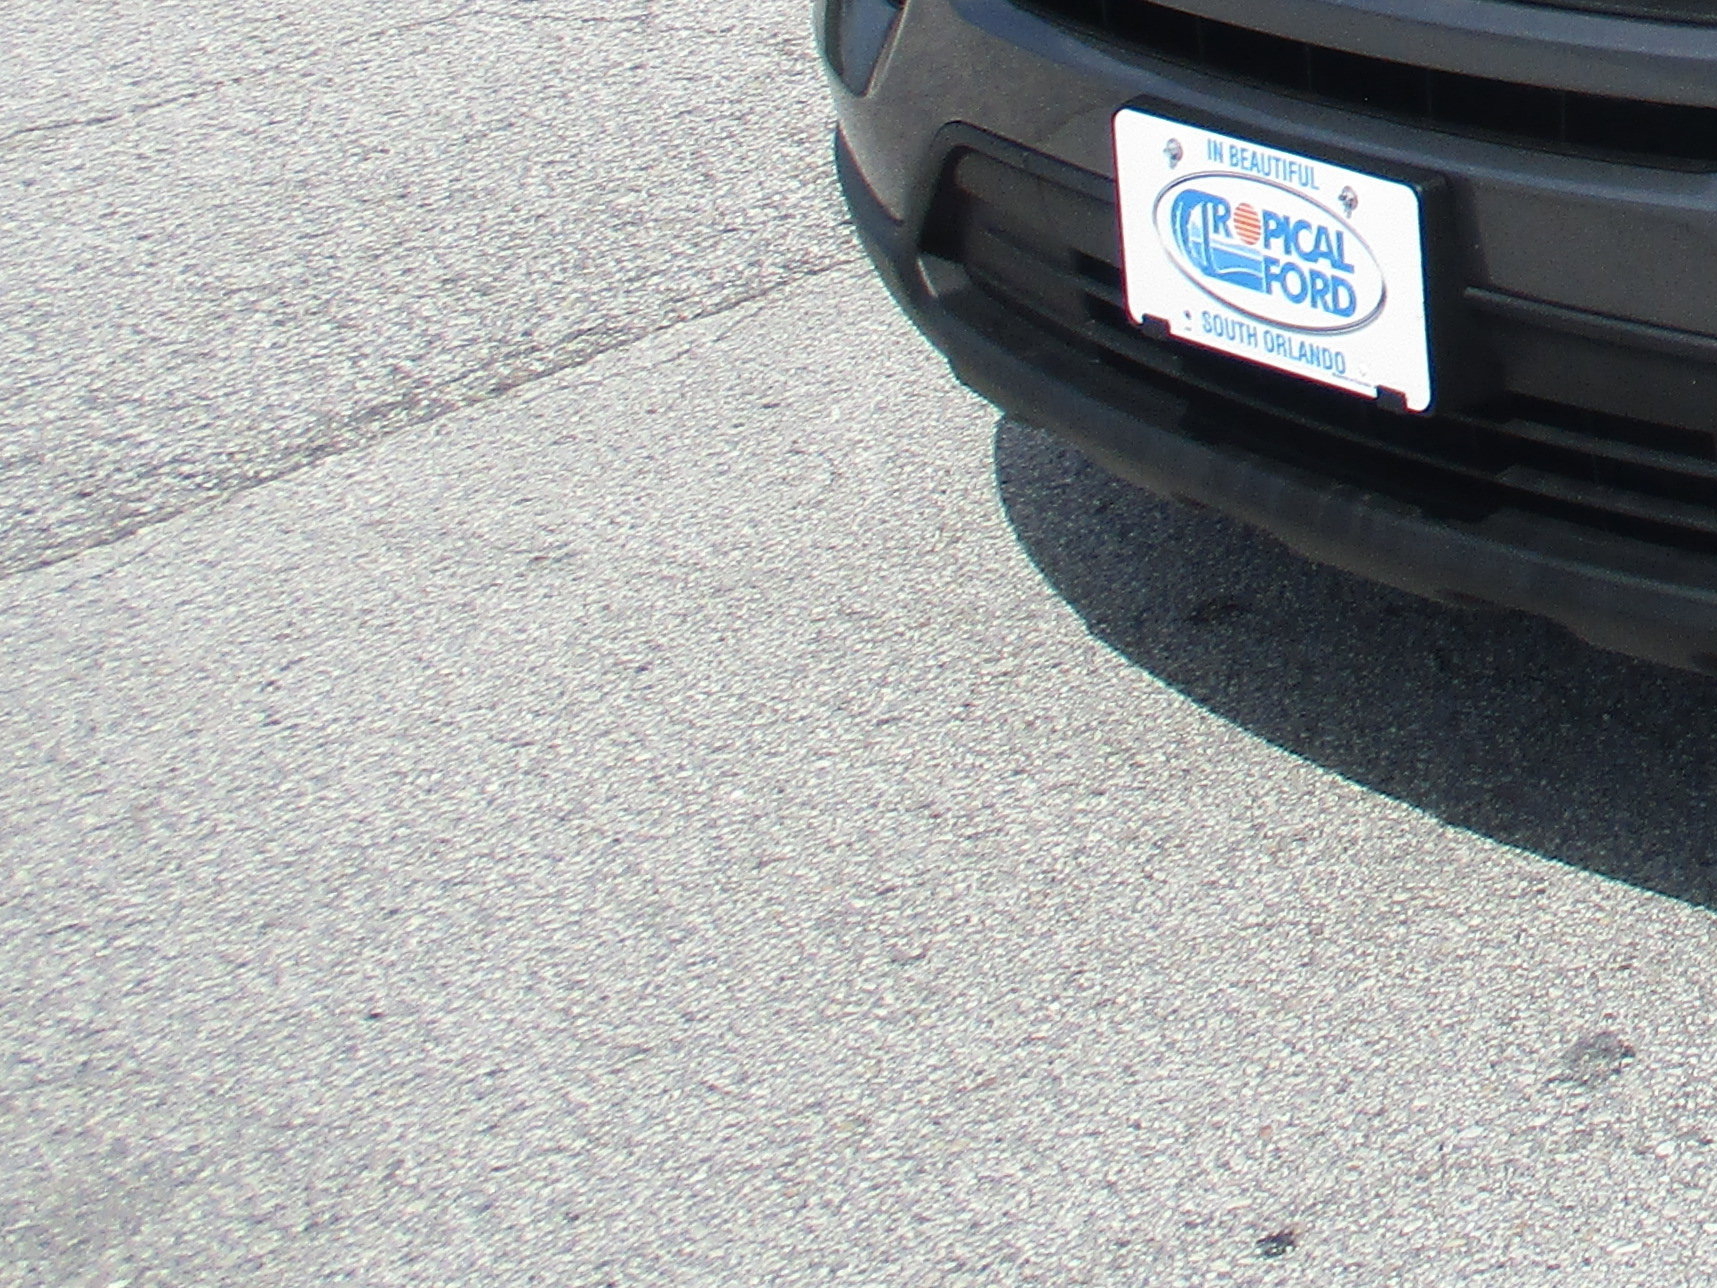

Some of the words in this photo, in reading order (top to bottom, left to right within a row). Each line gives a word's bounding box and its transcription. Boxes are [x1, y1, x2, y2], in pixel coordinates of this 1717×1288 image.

[1206, 138, 1226, 164] IN
[1229, 146, 1319, 189] BEAUTIFUL
[1171, 189, 1356, 274] TROPICAL
[1263, 256, 1357, 319] FORD
[1202, 310, 1259, 348] SOUTH
[1263, 328, 1348, 375] ORLANDO
